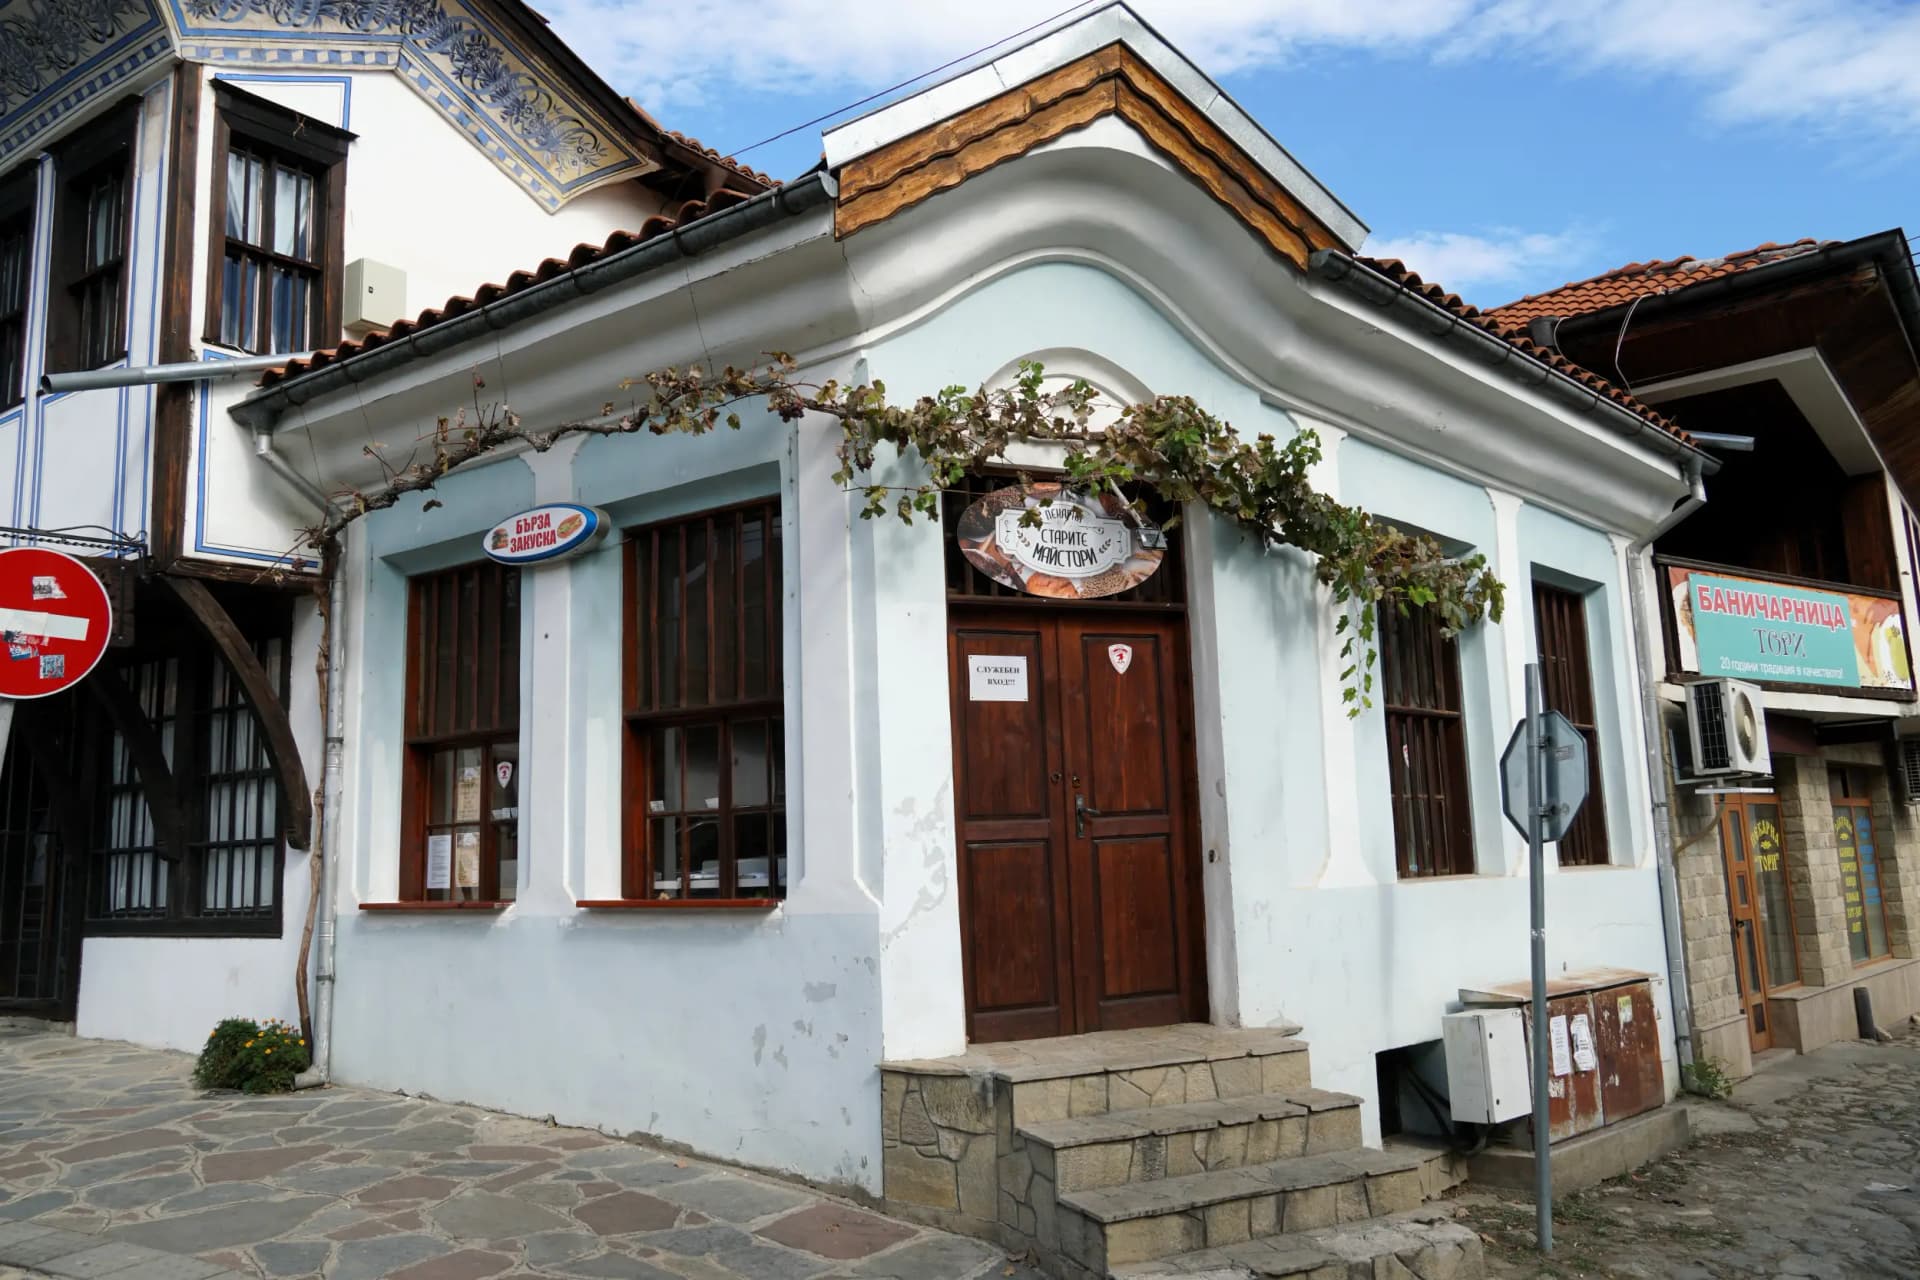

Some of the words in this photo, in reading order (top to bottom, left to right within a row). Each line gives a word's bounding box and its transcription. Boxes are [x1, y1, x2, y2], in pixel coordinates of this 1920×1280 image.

[515, 512, 551, 535] БЪРЗА
[1044, 508, 1083, 523] ПЕКАН
[510, 529, 557, 553] ЗАКУСКА
[1041, 528, 1088, 547] СТАРИТЕ
[1032, 542, 1098, 568] МАЙСТОРИ
[1697, 585, 1847, 632] БАНИЧАРНИЦА
[1753, 628, 1807, 658] ТОРИ
[976, 665, 1020, 674] СЛУЖЕБЕН
